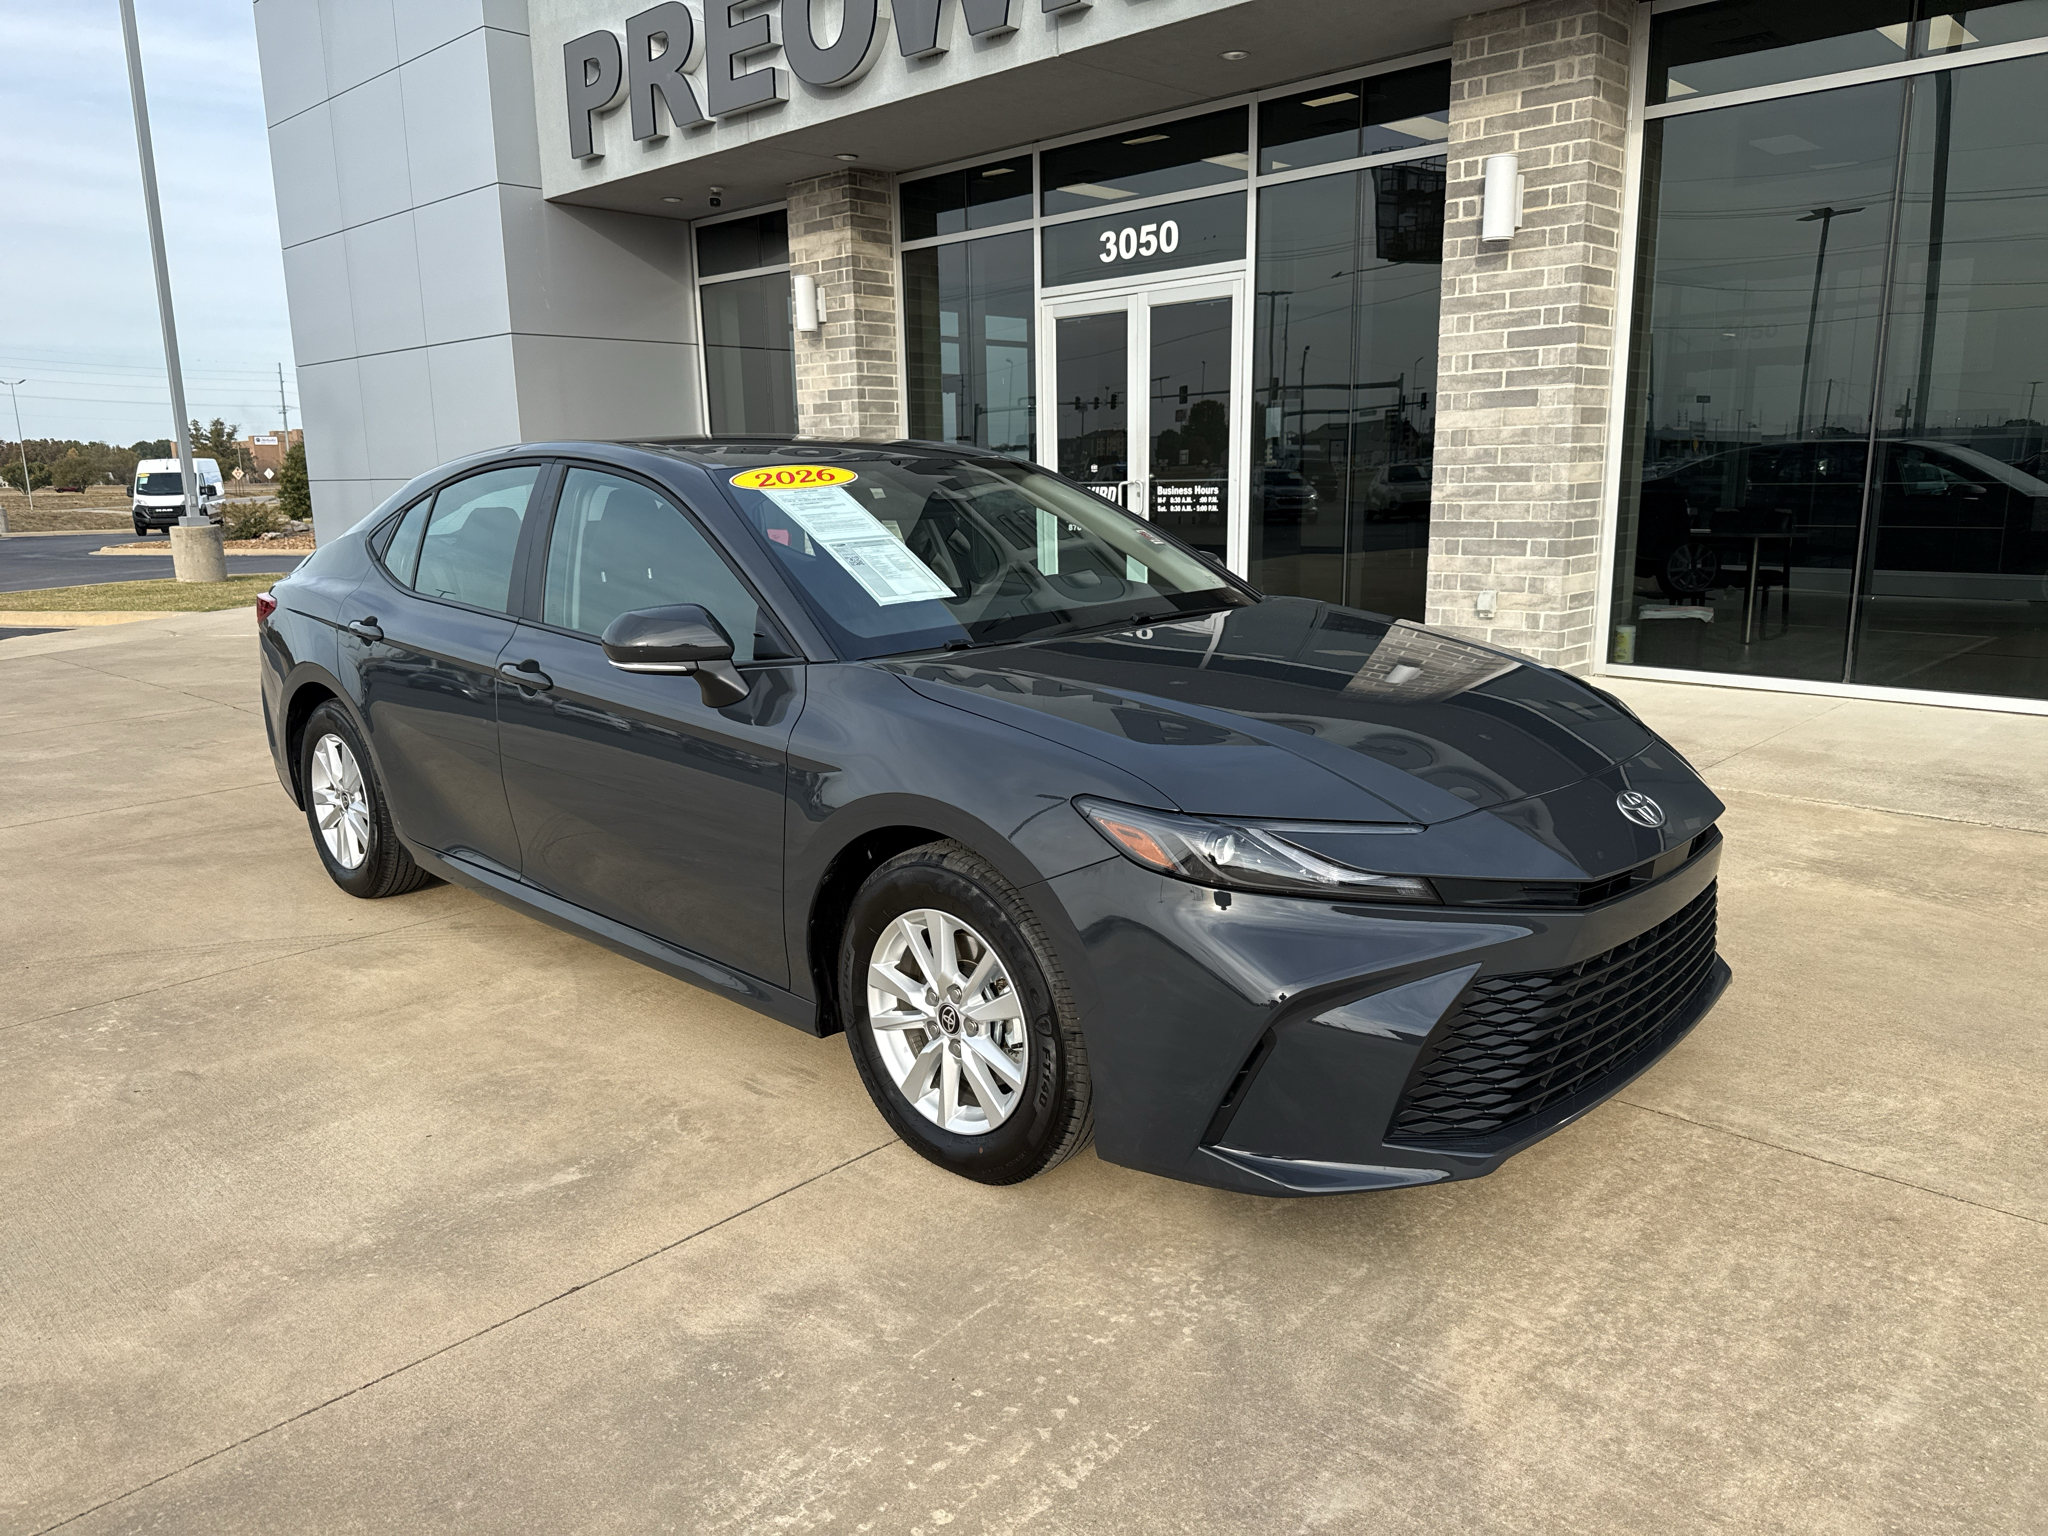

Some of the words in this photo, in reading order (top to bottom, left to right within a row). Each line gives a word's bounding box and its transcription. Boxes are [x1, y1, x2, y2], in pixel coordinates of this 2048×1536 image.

[1099, 220, 1179, 263] 3050
[755, 468, 835, 488] 2026
[1157, 485, 1193, 495] Business
[1194, 484, 1219, 495] Hours
[1038, 1045, 1051, 1109] FT140
